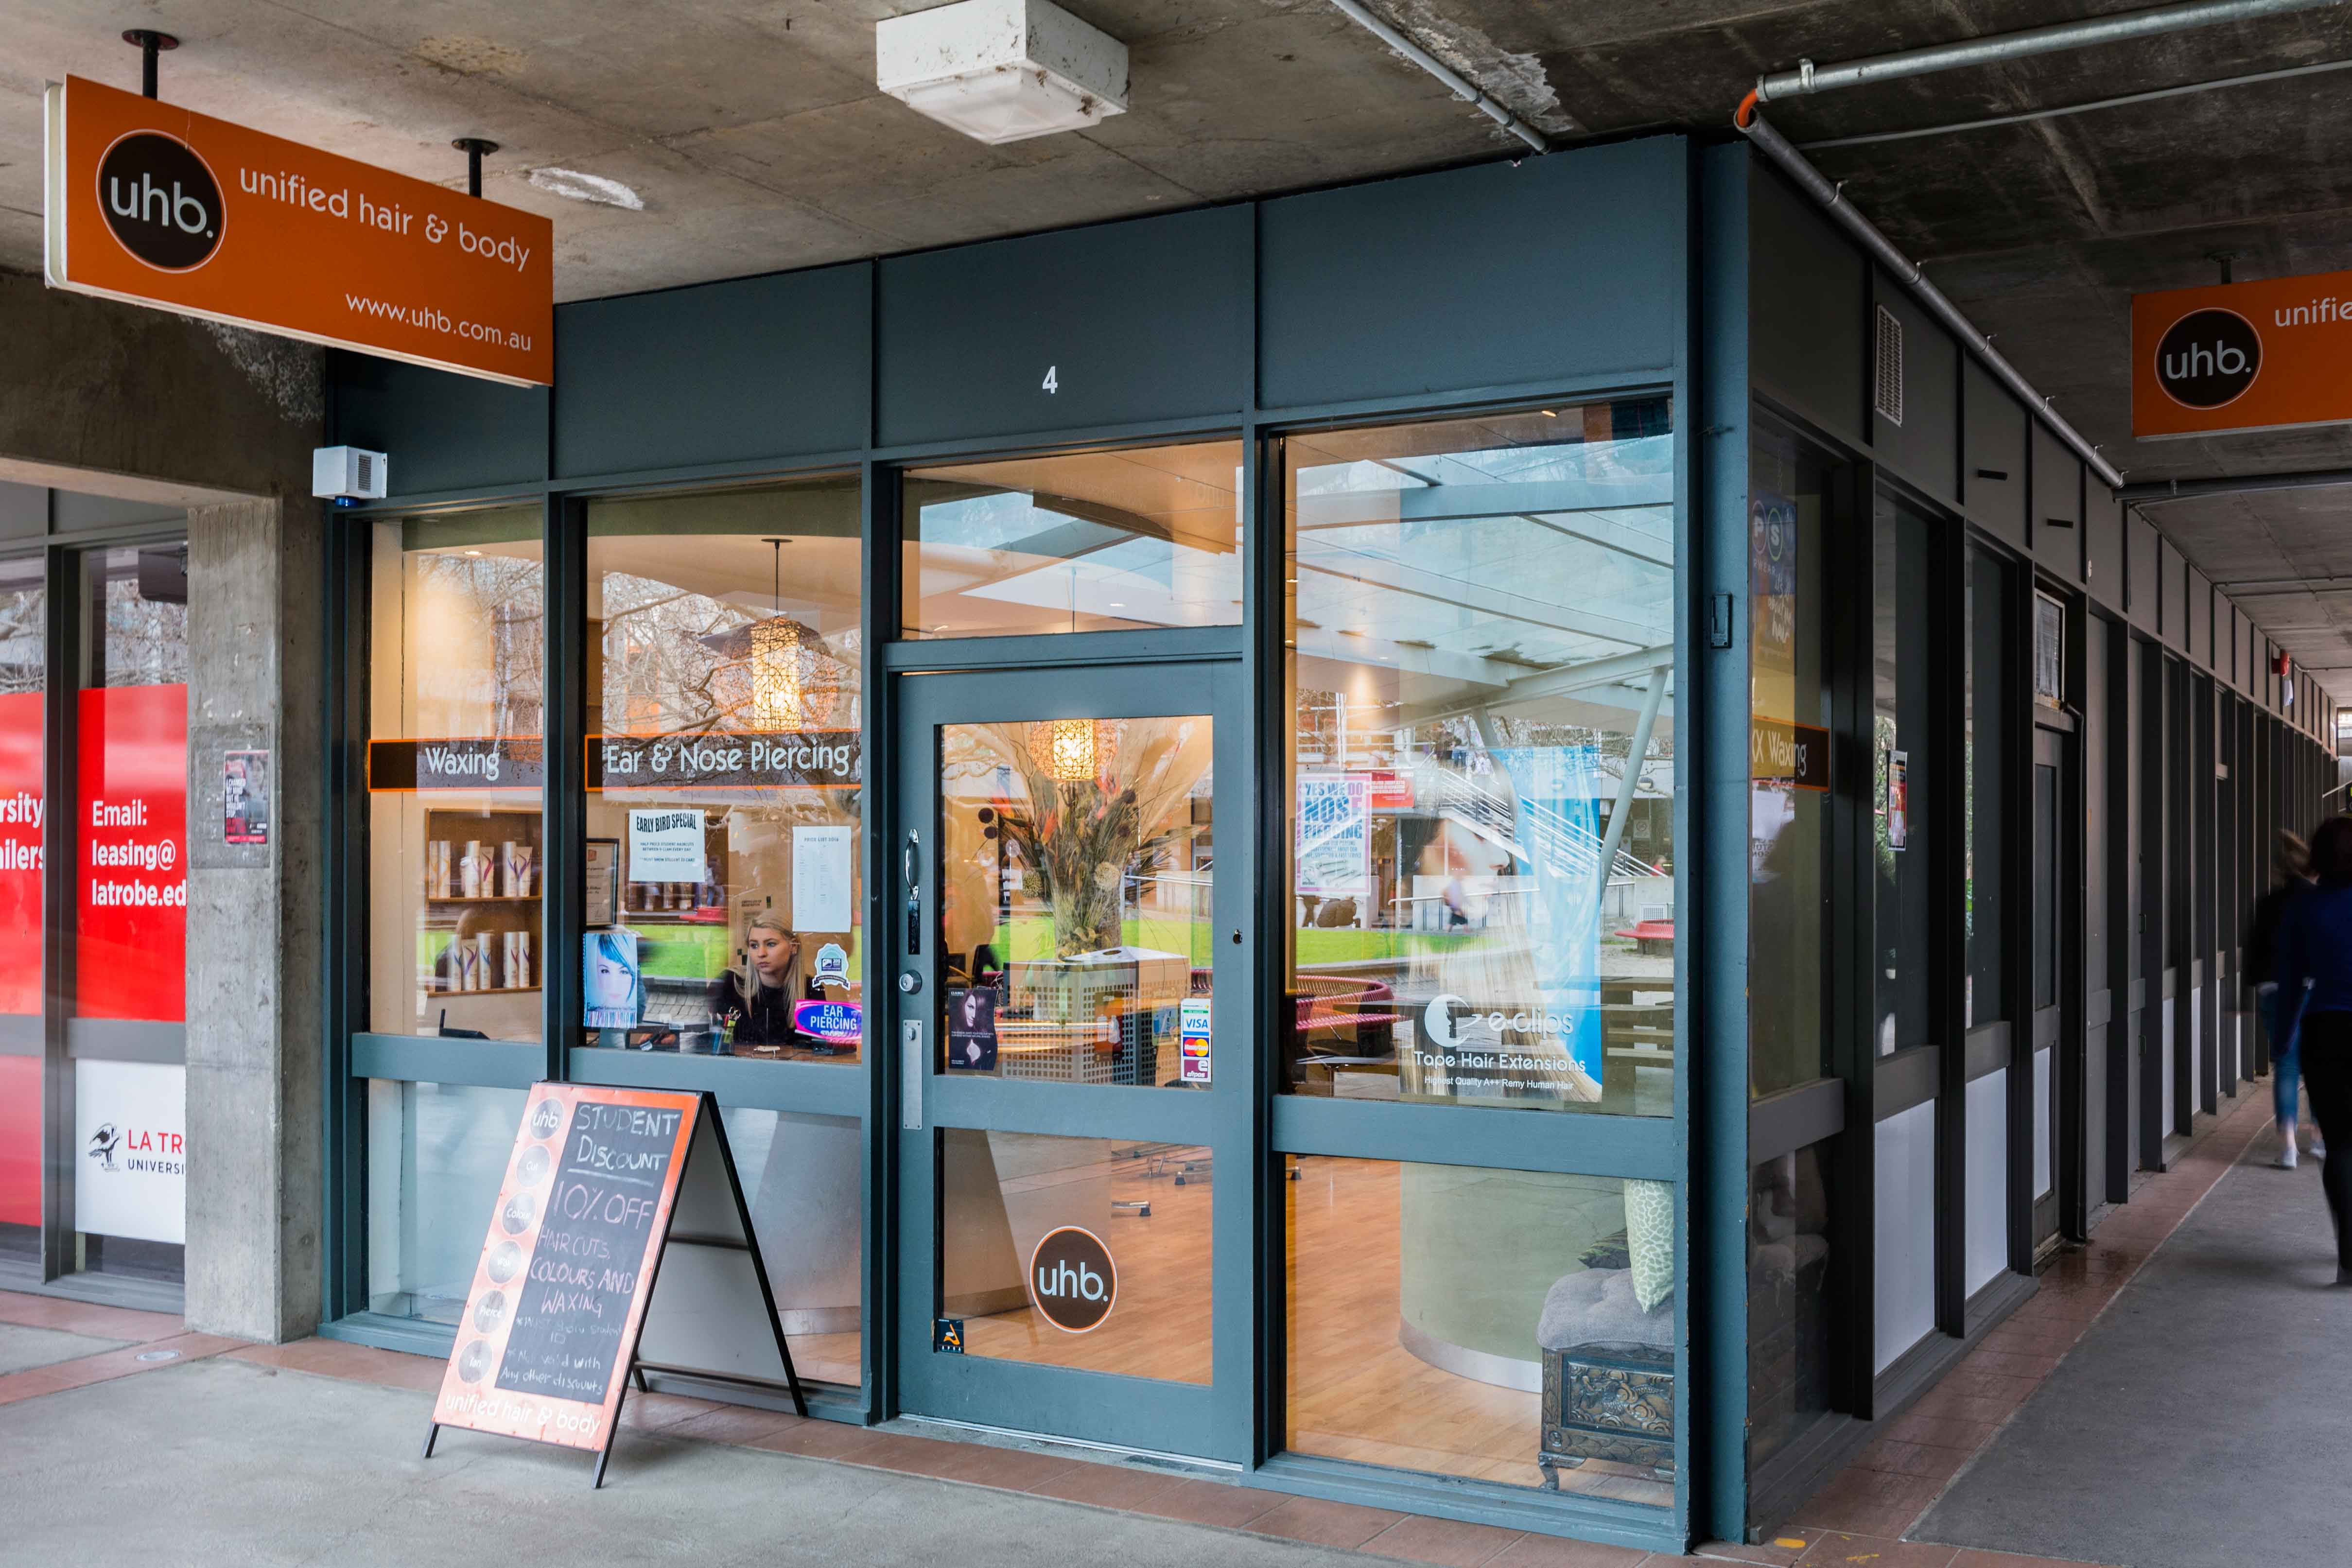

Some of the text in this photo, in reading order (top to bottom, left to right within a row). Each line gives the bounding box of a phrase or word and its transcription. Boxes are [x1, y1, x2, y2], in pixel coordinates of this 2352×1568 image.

[110, 173, 213, 238] uhb.
[240, 167, 530, 272] unified hair & body
[346, 293, 531, 352] www.uhb.com.au
[2275, 296, 2352, 327] unifie
[2166, 340, 2251, 380] uhb.
[1043, 366, 1058, 394] 4
[425, 746, 500, 781] Waxing
[606, 739, 850, 777] Ear & Nose Piercing
[1768, 731, 1808, 777] Waxing
[1305, 783, 1324, 796] YES
[1327, 782, 1345, 796] WE
[1348, 783, 1363, 796] DO
[92, 799, 147, 826] Email:
[636, 813, 697, 833] EARLY BIRD SPECIAL
[92, 838, 176, 871] leasing@
[92, 878, 187, 906] latrobe.ed
[810, 1016, 857, 1030] PIERCING
[824, 1005, 843, 1017] EAR
[1186, 1018, 1208, 1028] VISA
[1413, 1050, 1586, 1072] Tape Hair Extensions
[1424, 1076, 1574, 1090] Highest Quality A++ Remy Human Hair
[576, 1104, 680, 1138] STUDENT
[127, 1129, 186, 1154] LA TR
[127, 1159, 184, 1175] UNIVERSI
[506, 1207, 531, 1219] Colour
[553, 1180, 654, 1230] 10% OFF
[530, 1256, 635, 1295] COLOURS AND
[1039, 1259, 1108, 1302] uhb.
[479, 1305, 503, 1318] Pierce
[540, 1286, 603, 1319] WAXING
[574, 1356, 601, 1370] with
[499, 1366, 603, 1395] Any other discounts
[445, 1392, 601, 1439] unified hair & body
